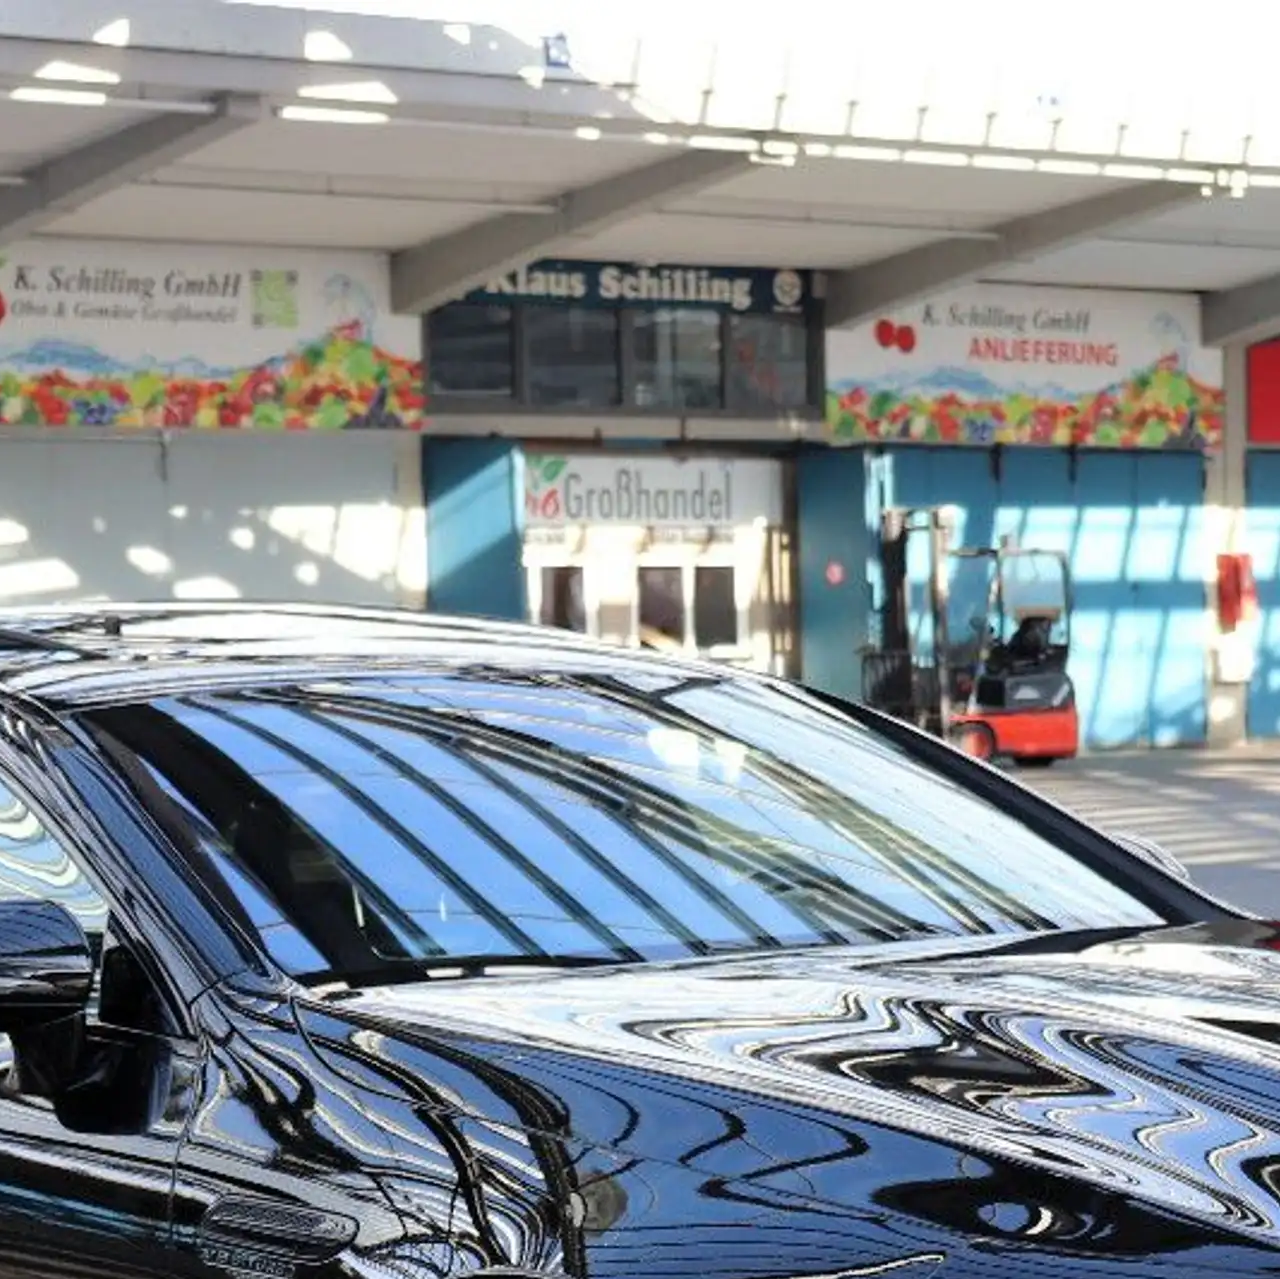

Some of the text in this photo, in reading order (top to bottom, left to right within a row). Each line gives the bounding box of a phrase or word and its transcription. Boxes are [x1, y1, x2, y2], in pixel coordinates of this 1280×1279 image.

[12, 264, 242, 299] K. Schilling GmbH
[599, 265, 752, 310] Schilling
[946, 304, 1026, 332] Schilling
[1033, 307, 1091, 333] GmbH
[968, 337, 1119, 367] ANLIEFERUNG
[564, 468, 733, 521] Großhandel
